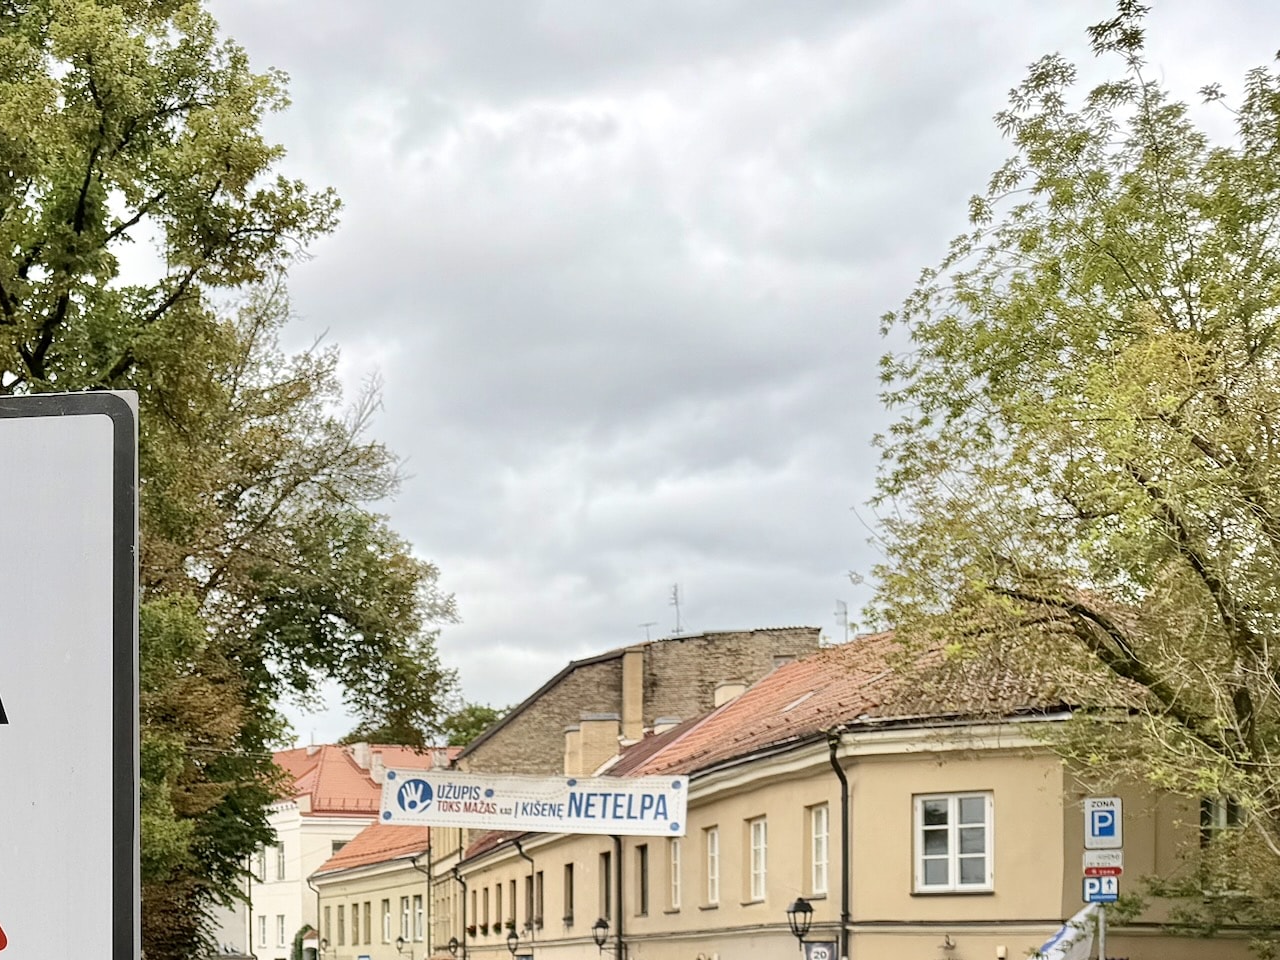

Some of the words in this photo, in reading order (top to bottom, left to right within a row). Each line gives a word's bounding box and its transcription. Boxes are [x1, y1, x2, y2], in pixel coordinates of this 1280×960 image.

[437, 784, 481, 801] UŽUPIS
[437, 800, 461, 812] TOKS
[521, 799, 565, 821] KIŠENĘ
[567, 792, 668, 820] NETELPA
[813, 951, 827, 960] 20
